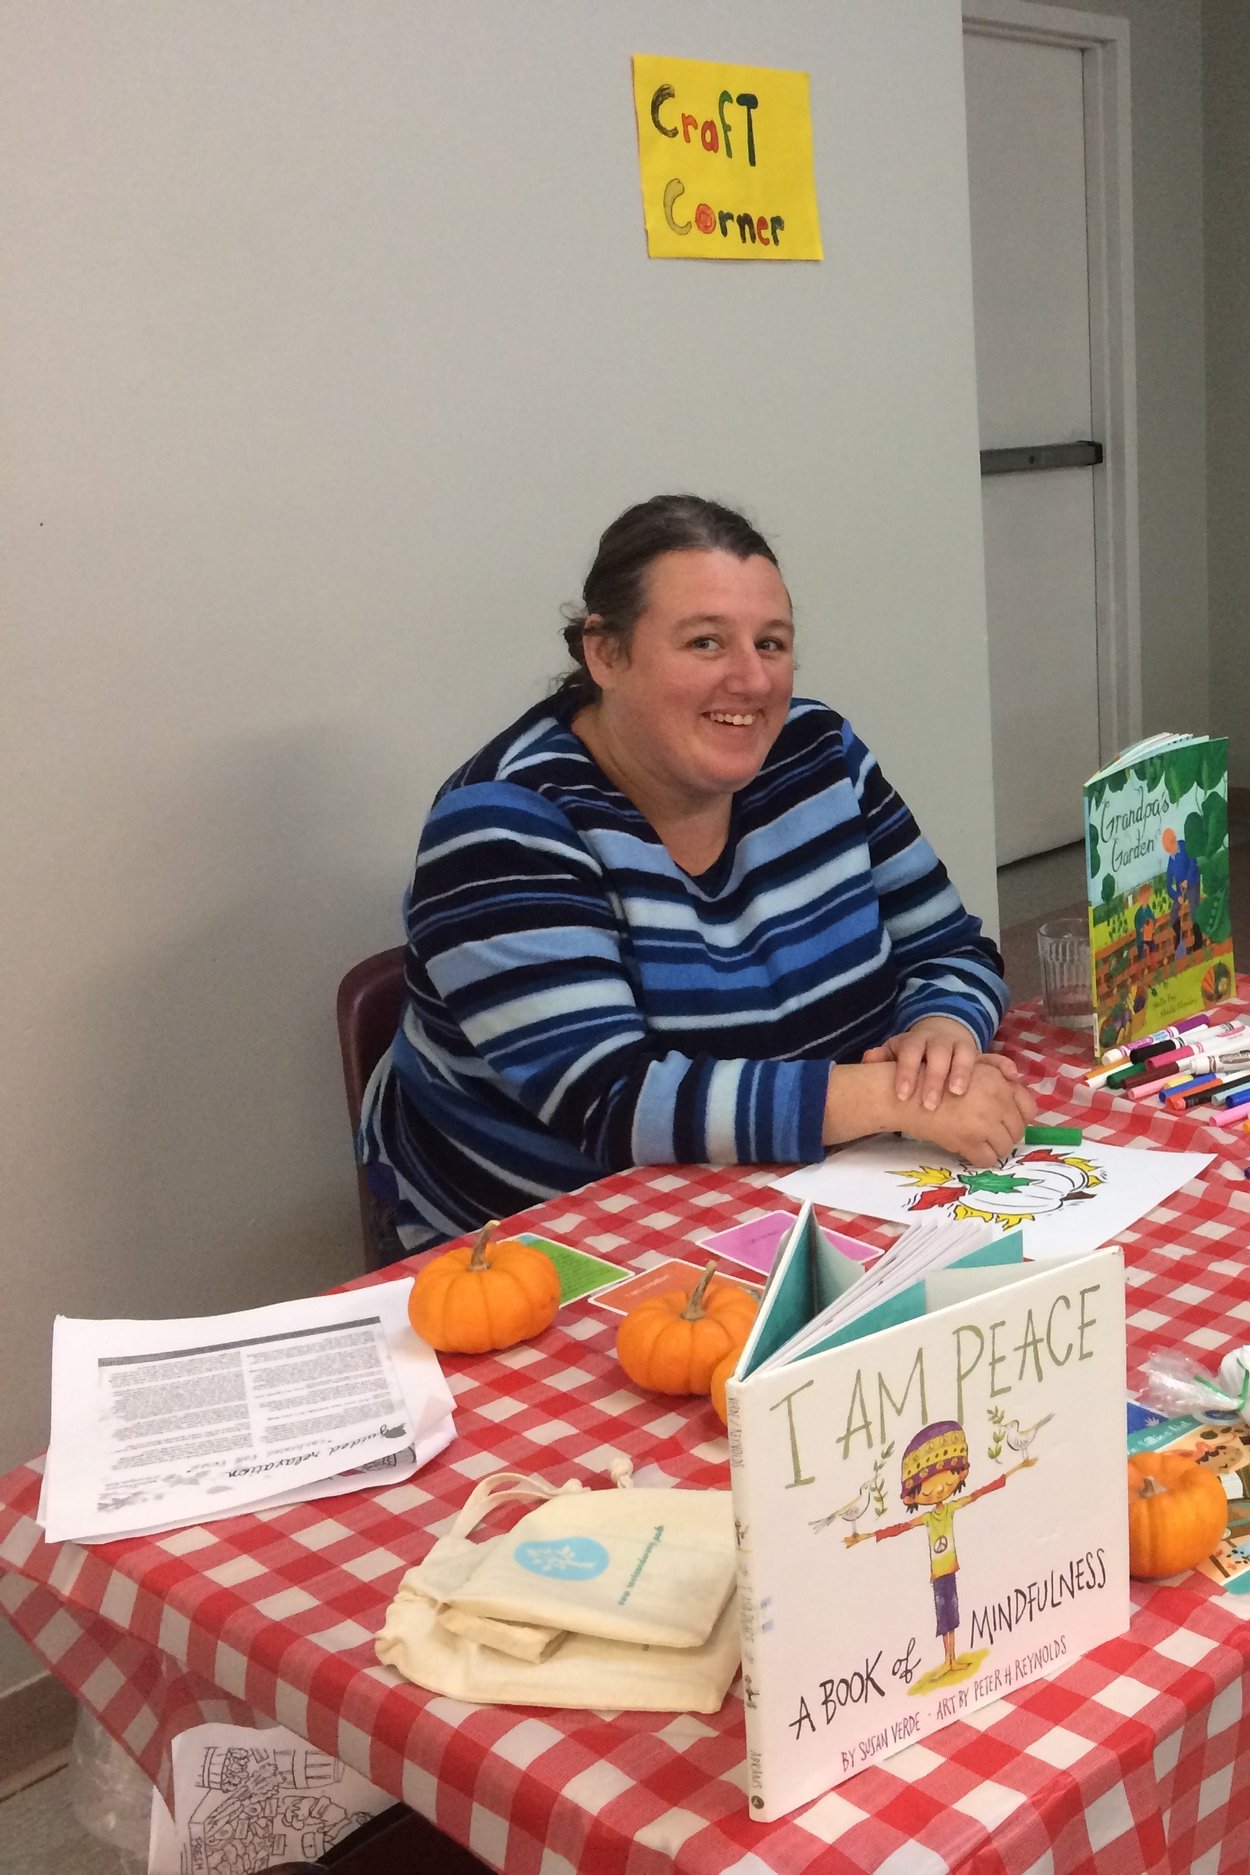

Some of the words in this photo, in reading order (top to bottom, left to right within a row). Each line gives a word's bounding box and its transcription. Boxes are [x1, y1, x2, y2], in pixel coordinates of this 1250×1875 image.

[662, 178, 785, 246] Corner
[1101, 785, 1170, 843] Grandpa's
[1111, 828, 1155, 872] Garden
[769, 1380, 815, 1489] I
[836, 1347, 929, 1460] AM
[952, 1284, 1101, 1425] PEACE
[227, 1450, 320, 1478] relaxation
[789, 1695, 816, 1740] A
[819, 1651, 885, 1726] BOOK
[892, 1637, 921, 1684] of
[970, 1548, 1108, 1649] MINDFULNESS
[841, 1748, 856, 1772] BY
[858, 1728, 888, 1761] SUSAN
[891, 1712, 921, 1743] VERDE
[936, 1696, 956, 1720] ART
[959, 1687, 969, 1708] BY
[974, 1669, 1003, 1701] PETER
[1004, 1664, 1012, 1686] H
[1015, 1634, 1067, 1681] REYNOLDS
